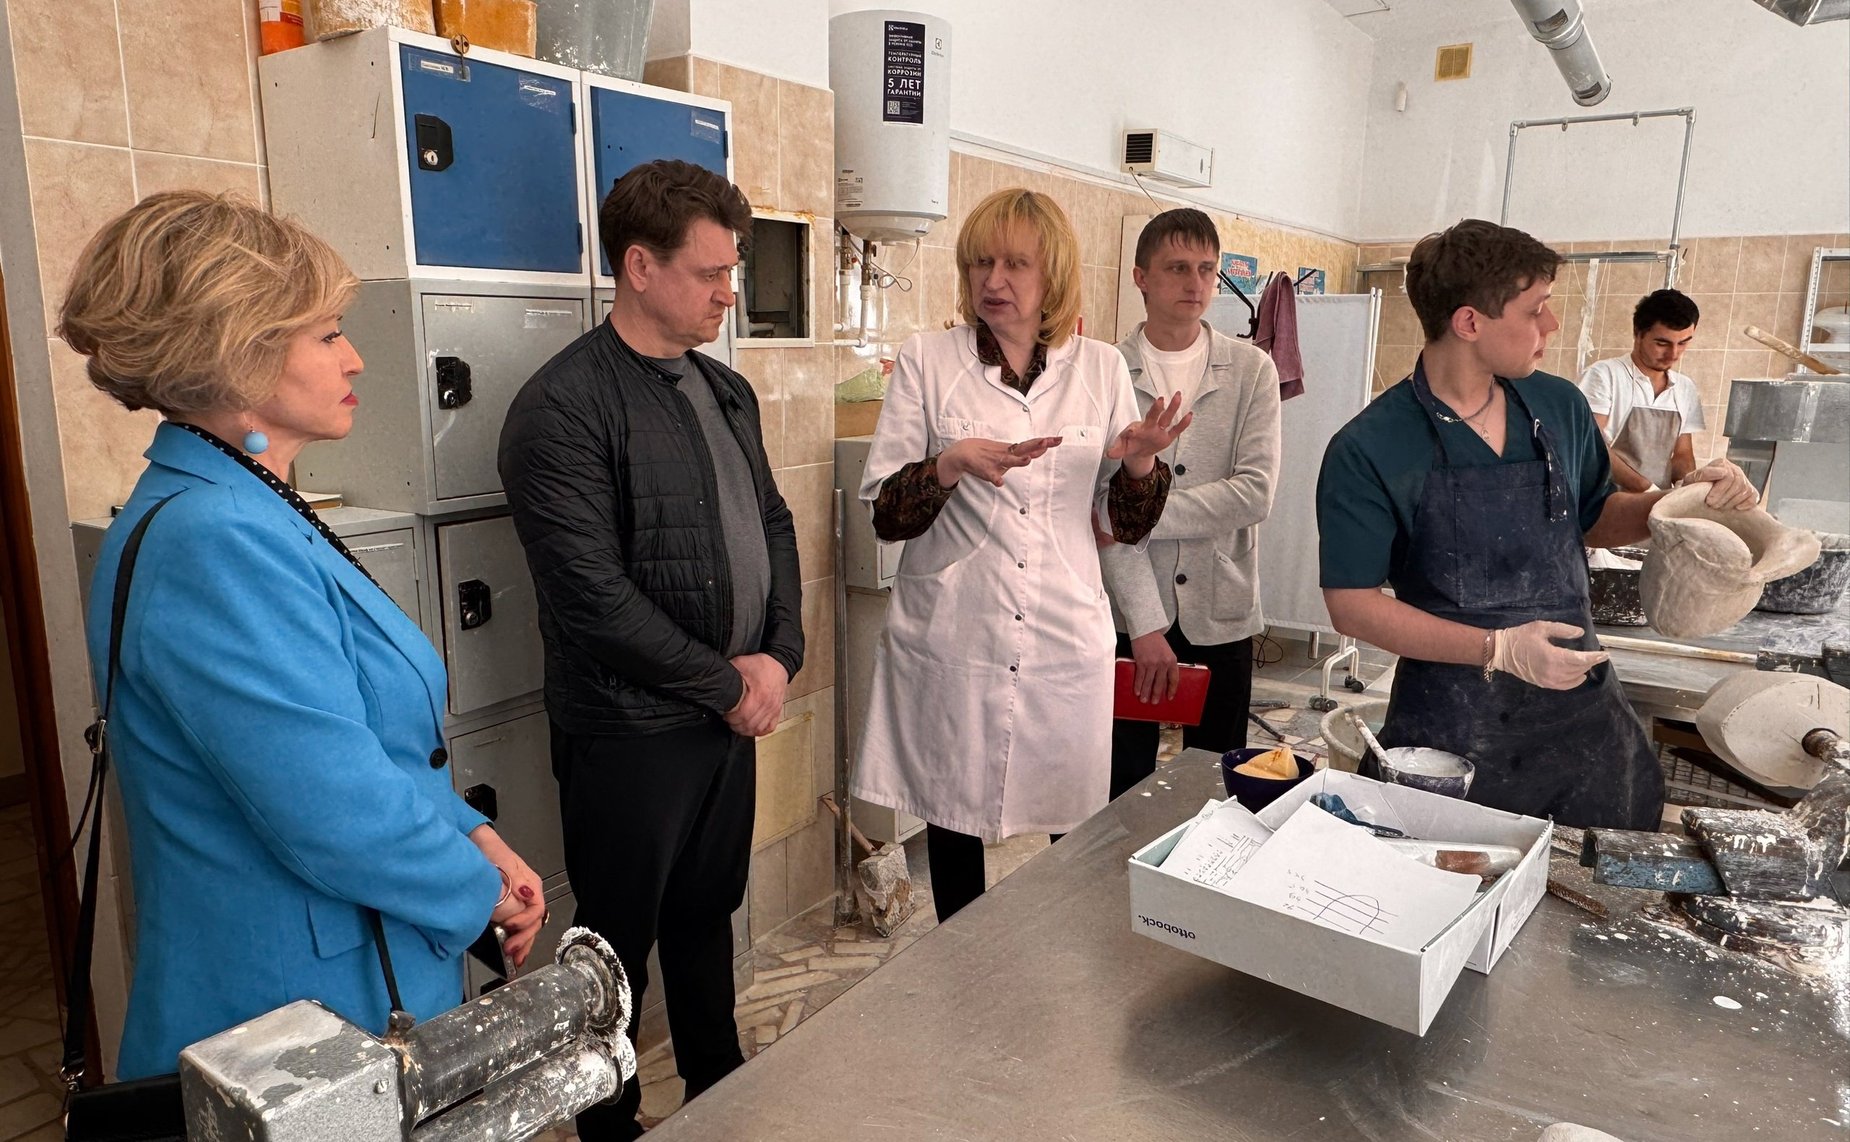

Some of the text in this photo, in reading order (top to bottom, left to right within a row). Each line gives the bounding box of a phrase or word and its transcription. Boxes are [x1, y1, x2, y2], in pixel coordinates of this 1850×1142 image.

[887, 69, 921, 77] КОРРОЗИИ
[888, 78, 921, 90] 5 ЛЕТ
[887, 89, 921, 97] ГАРАНТИИ
[1138, 914, 1196, 939] ottobock.
